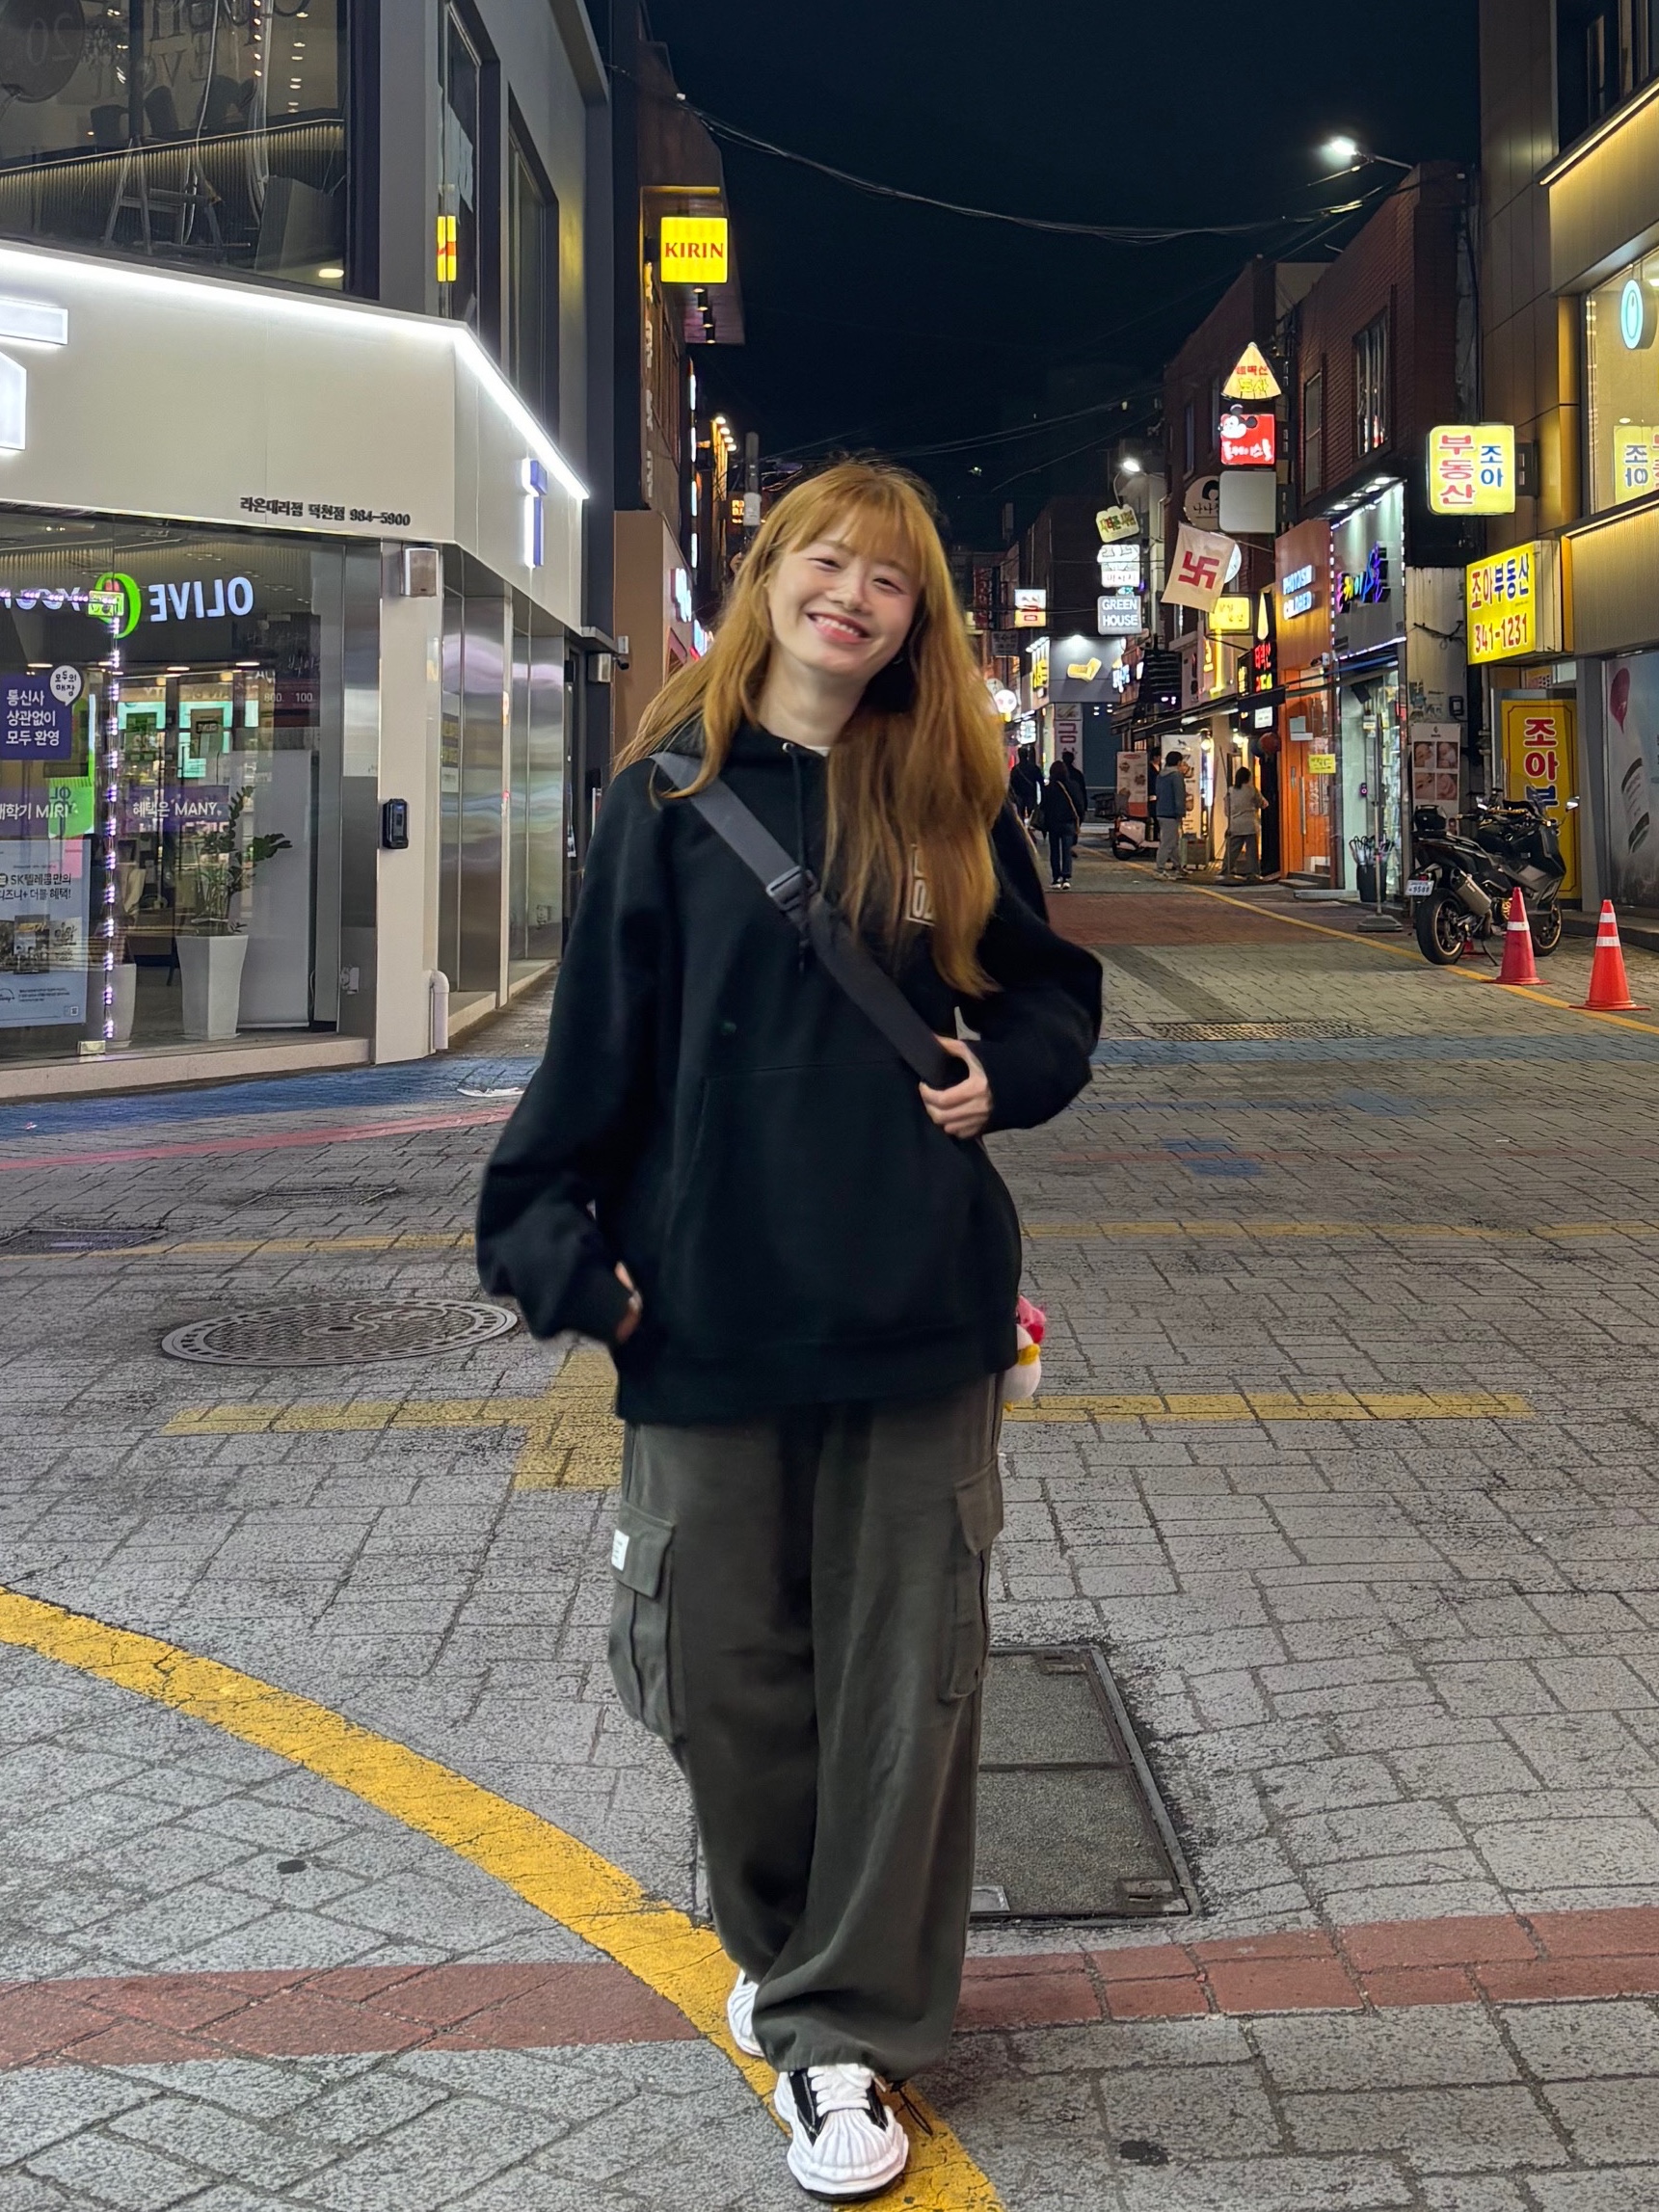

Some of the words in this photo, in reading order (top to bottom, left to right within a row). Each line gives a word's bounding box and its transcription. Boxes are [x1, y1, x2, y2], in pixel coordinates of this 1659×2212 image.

[665, 242, 723, 258] KIRIN
[1439, 435, 1476, 505] 부동산
[1481, 445, 1504, 488] 조아
[240, 496, 304, 517] 라온대리점
[308, 503, 345, 521] 덕천점
[349, 508, 411, 526] 984-5900
[1193, 501, 1218, 516] 나나
[1471, 551, 1530, 609] 조아부동산
[1102, 599, 1137, 610] GREEN
[1102, 615, 1138, 626] HOUSE
[1474, 612, 1528, 654] 341-1231
[55, 670, 77, 682] 모두의
[7, 689, 44, 706] 통신사
[56, 684, 75, 697] 매장
[7, 709, 56, 727] 상관없이
[6, 730, 32, 746] 모두
[35, 730, 60, 746] 환영
[133, 802, 171, 817] 혜택은
